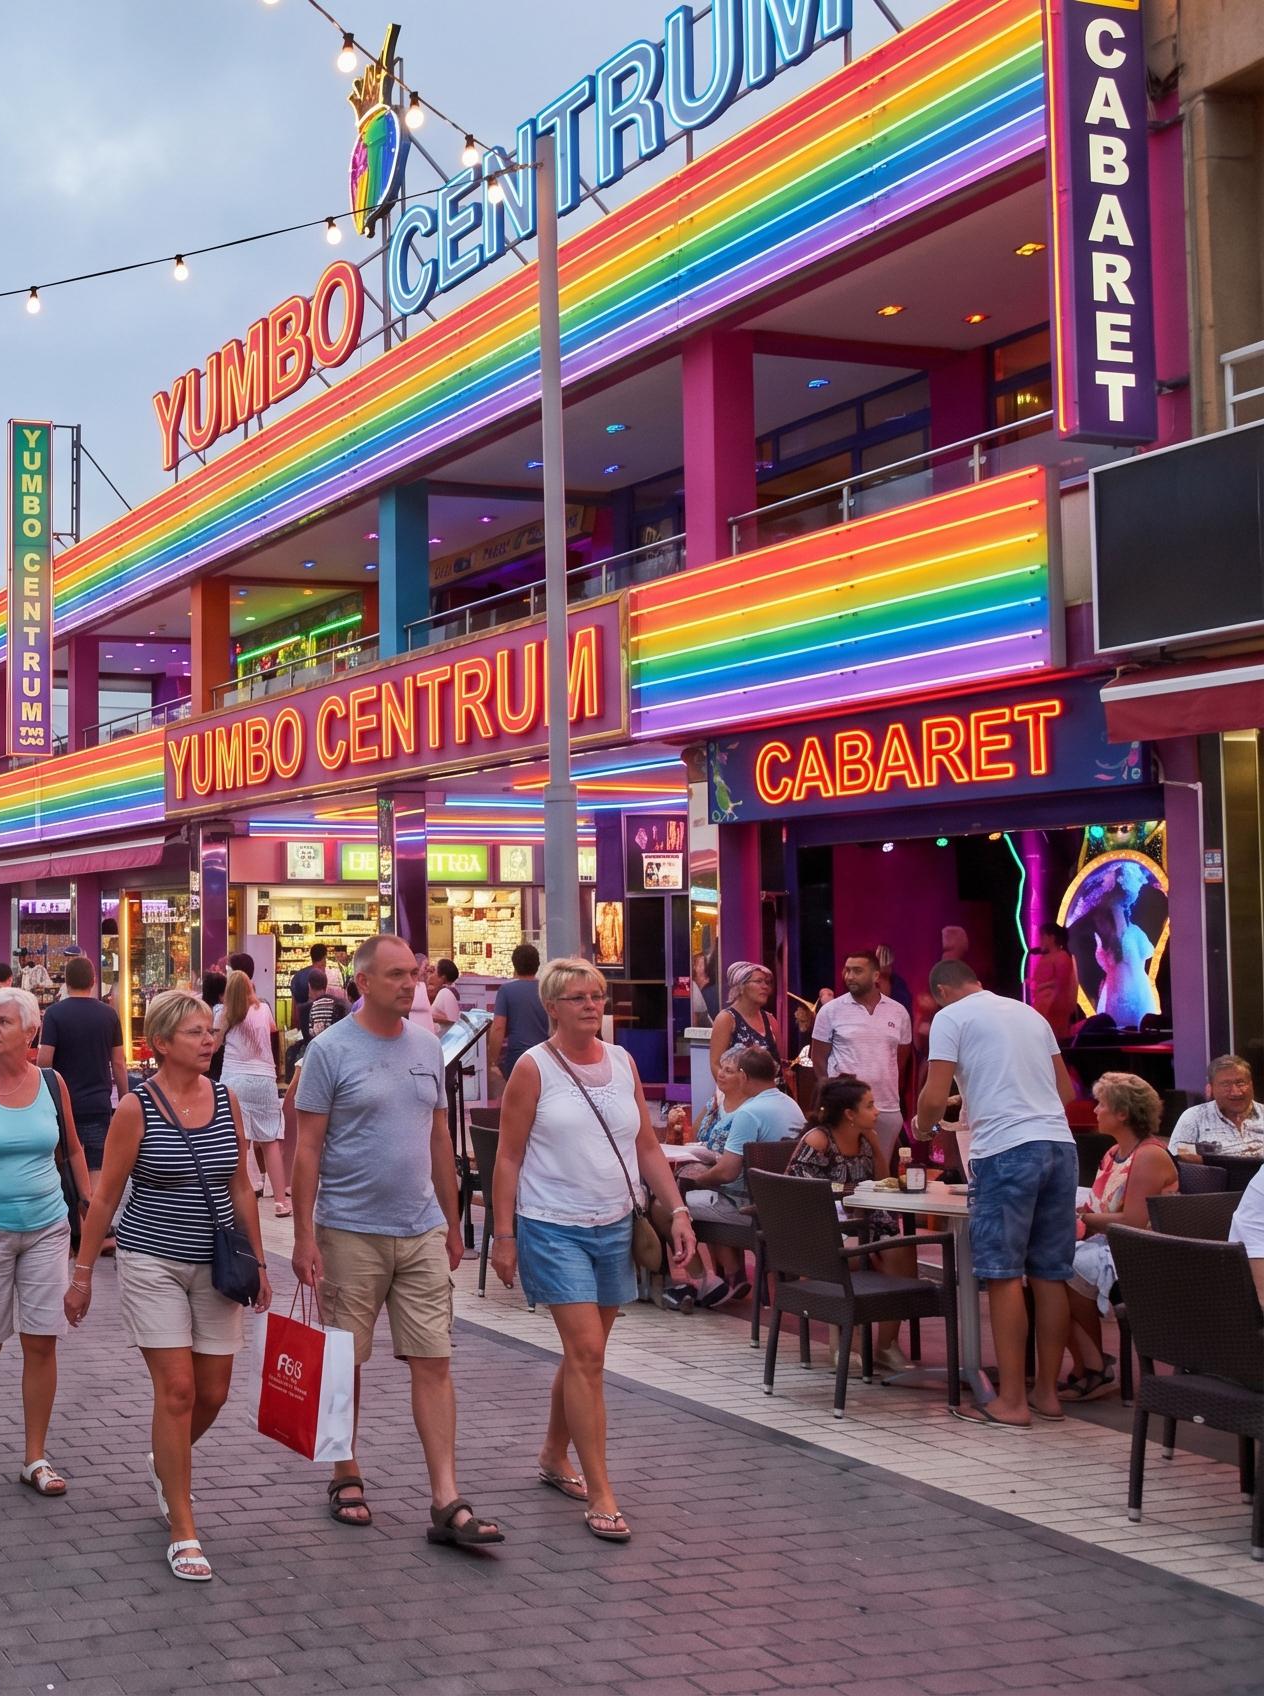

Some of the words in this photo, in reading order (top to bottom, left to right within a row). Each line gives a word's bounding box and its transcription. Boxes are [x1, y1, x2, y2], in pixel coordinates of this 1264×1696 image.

[1083, 17, 1137, 423] CABARET
[152, 260, 365, 471] YUMBO
[21, 428, 43, 539] YUMBO
[21, 552, 43, 723] CENTRUM
[167, 707, 305, 800] YUMBO
[316, 624, 602, 770] CENTRUM
[755, 700, 1061, 804] CABARET
